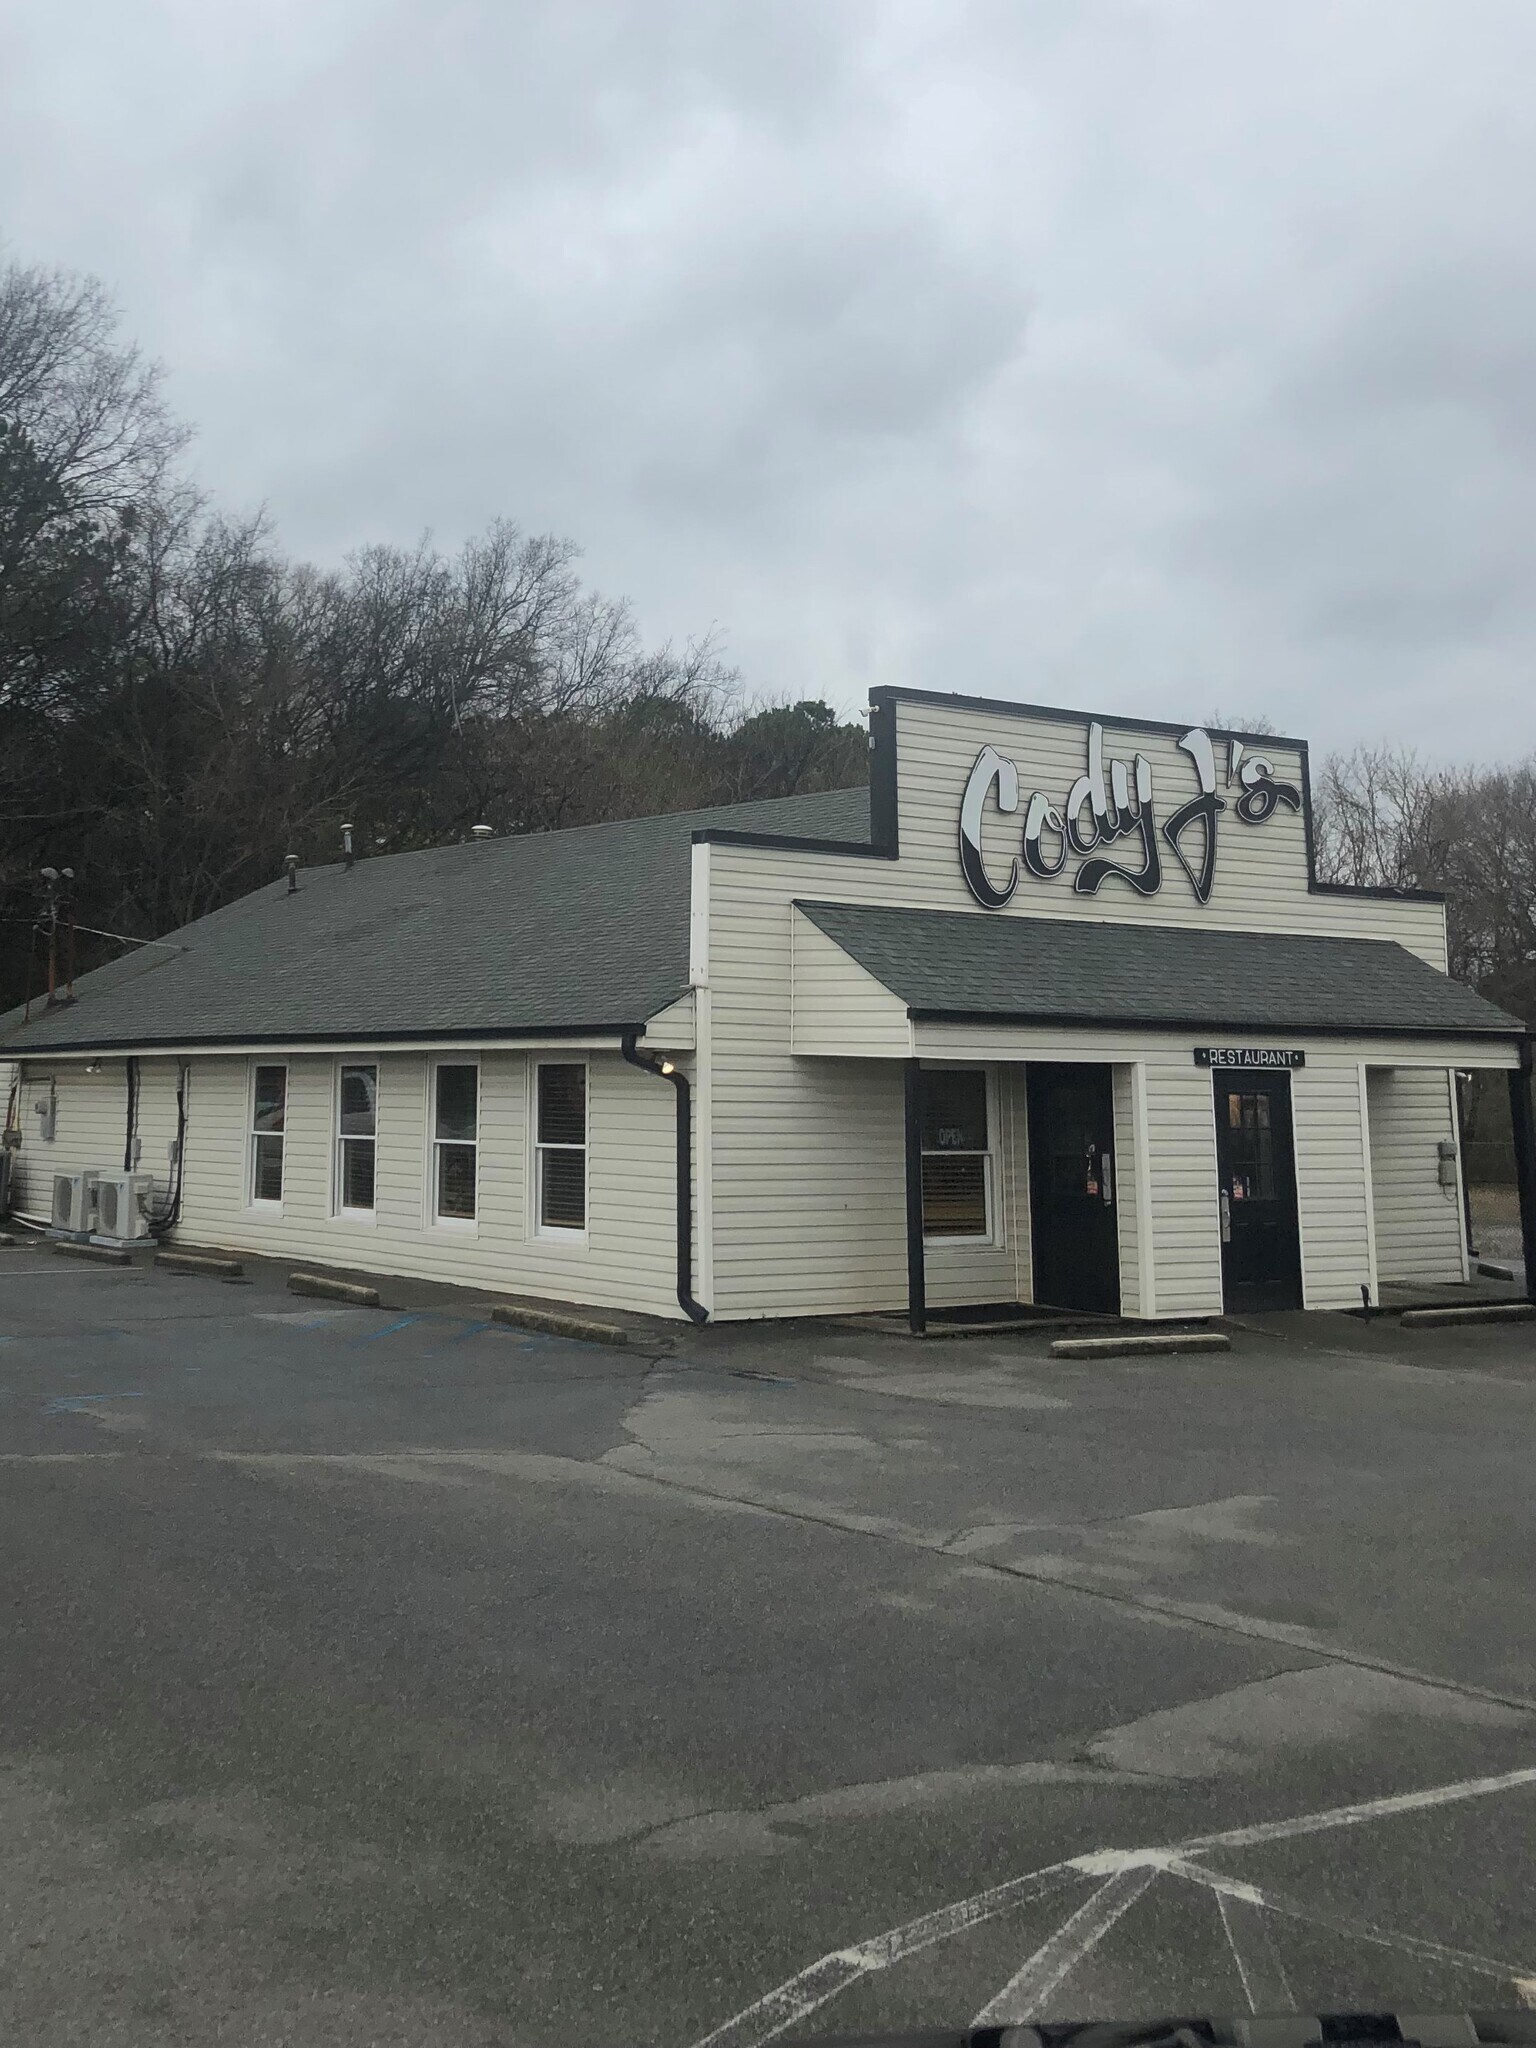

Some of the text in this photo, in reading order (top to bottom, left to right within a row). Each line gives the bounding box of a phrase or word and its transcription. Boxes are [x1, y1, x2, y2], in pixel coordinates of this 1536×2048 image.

[959, 721, 1301, 908] Cody J's
[1209, 1049, 1293, 1065] RESTAURANT
[938, 1128, 964, 1145] OPEN
